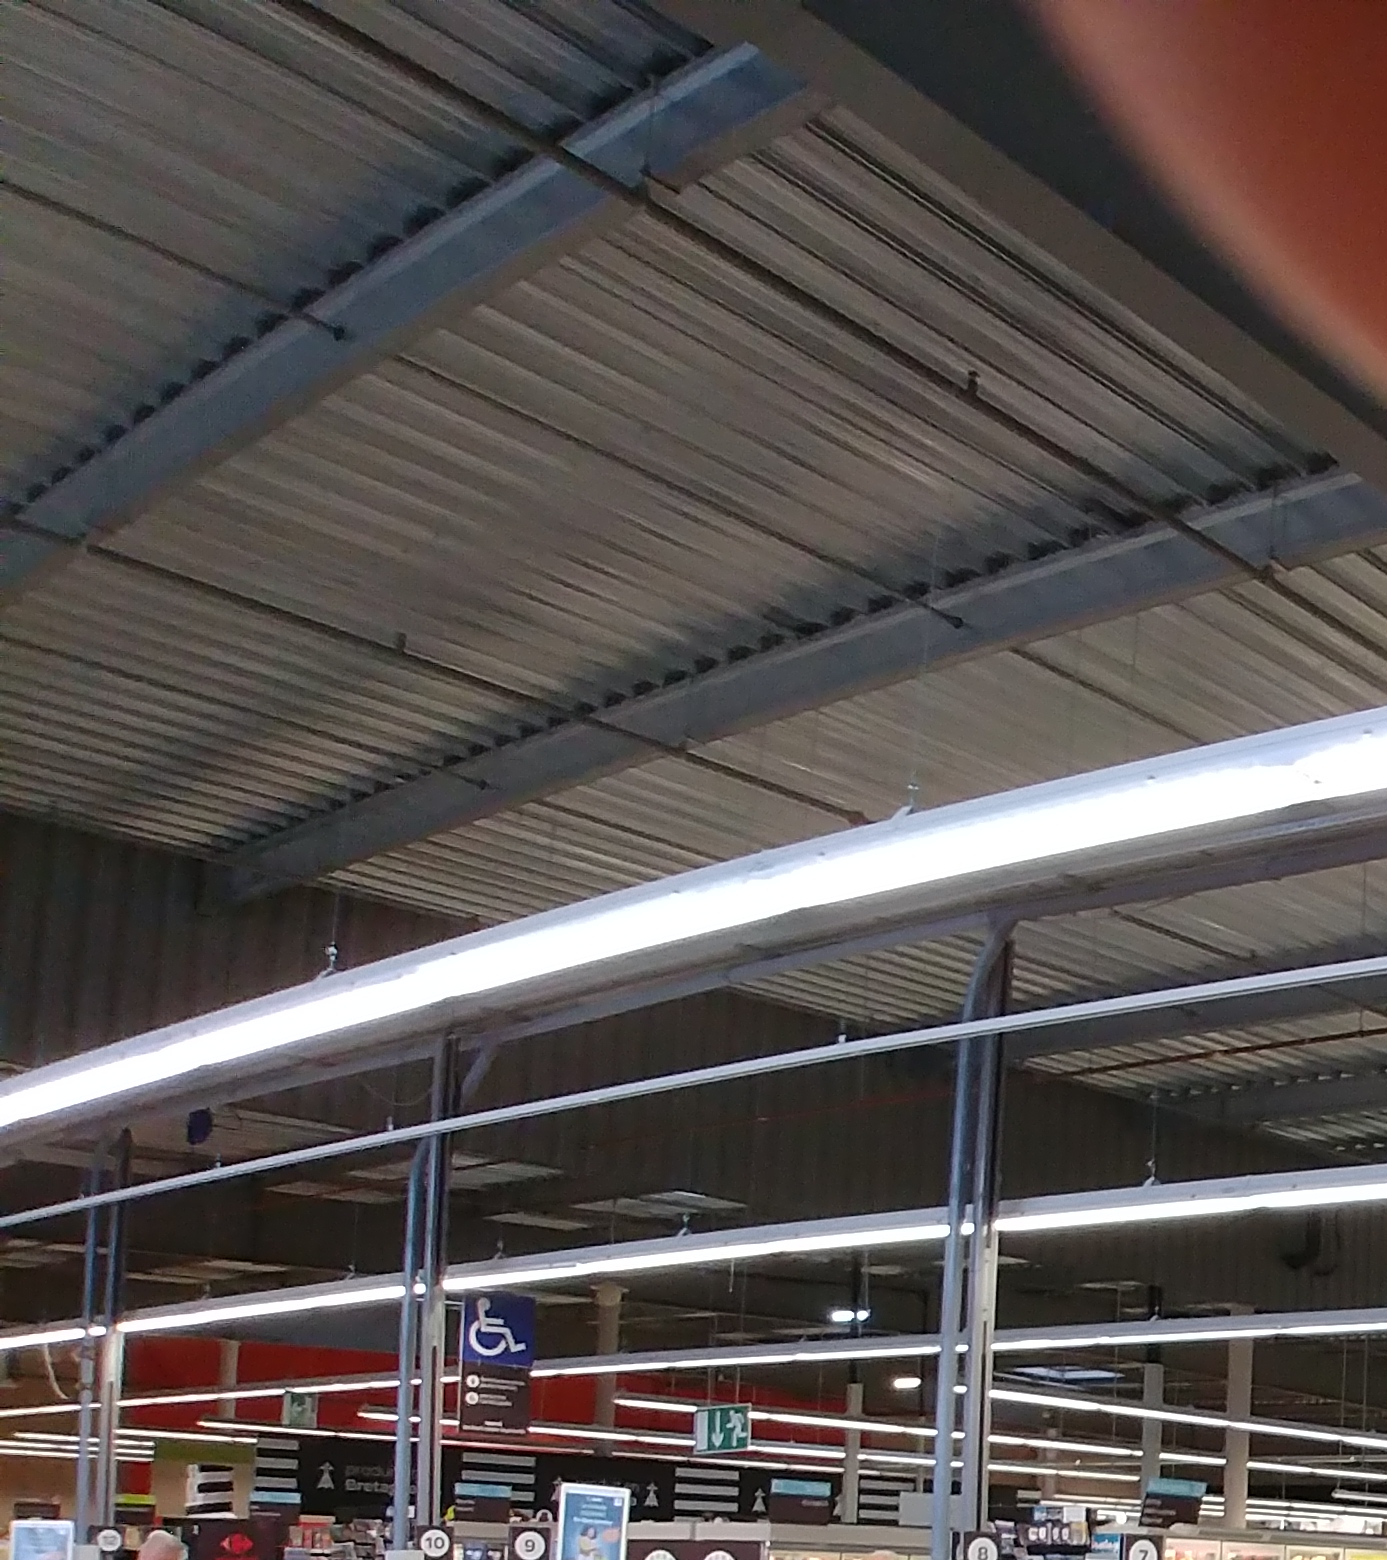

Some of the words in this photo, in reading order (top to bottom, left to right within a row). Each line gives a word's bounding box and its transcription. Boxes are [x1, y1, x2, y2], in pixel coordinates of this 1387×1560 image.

[425, 1537, 445, 1550] 10
[524, 1539, 536, 1553] 9
[977, 1547, 988, 1560] 8
